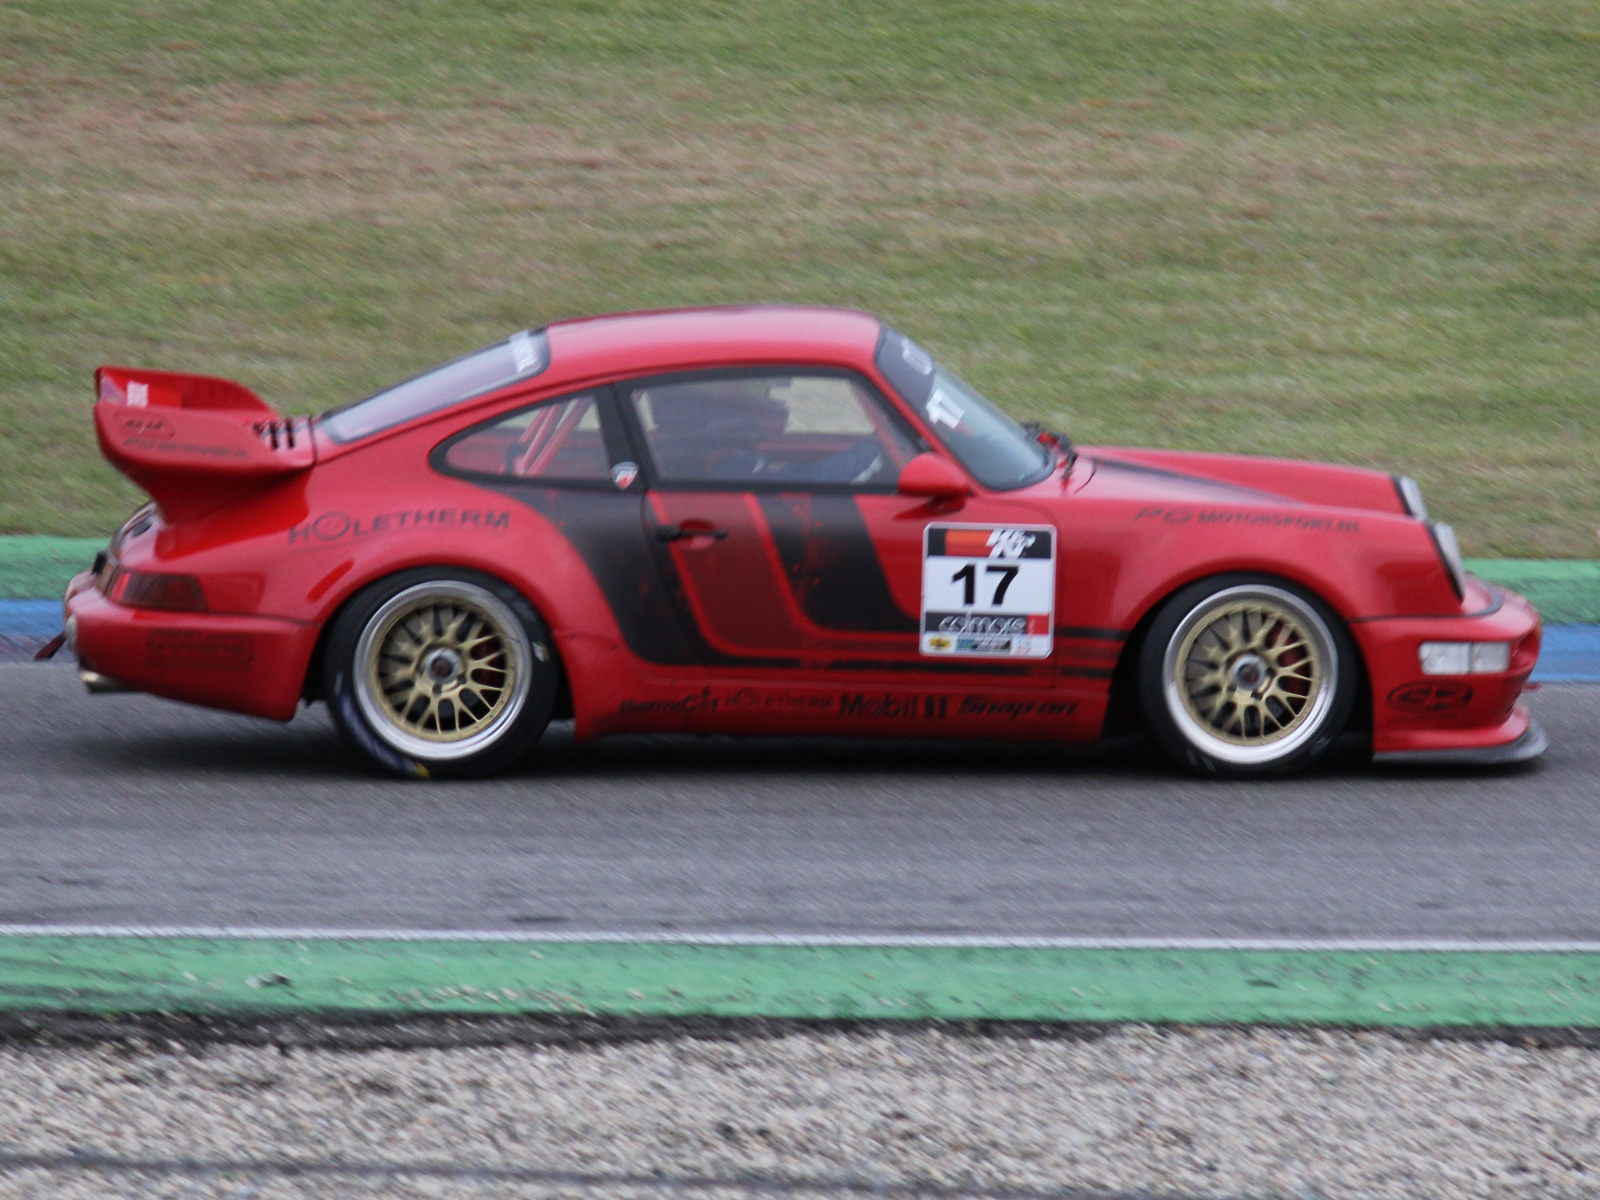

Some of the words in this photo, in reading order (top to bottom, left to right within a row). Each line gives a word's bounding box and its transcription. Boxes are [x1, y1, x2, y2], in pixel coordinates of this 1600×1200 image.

[289, 508, 510, 545] HOLETHERM
[951, 564, 1020, 606] 17
[838, 691, 918, 717] Mobil
